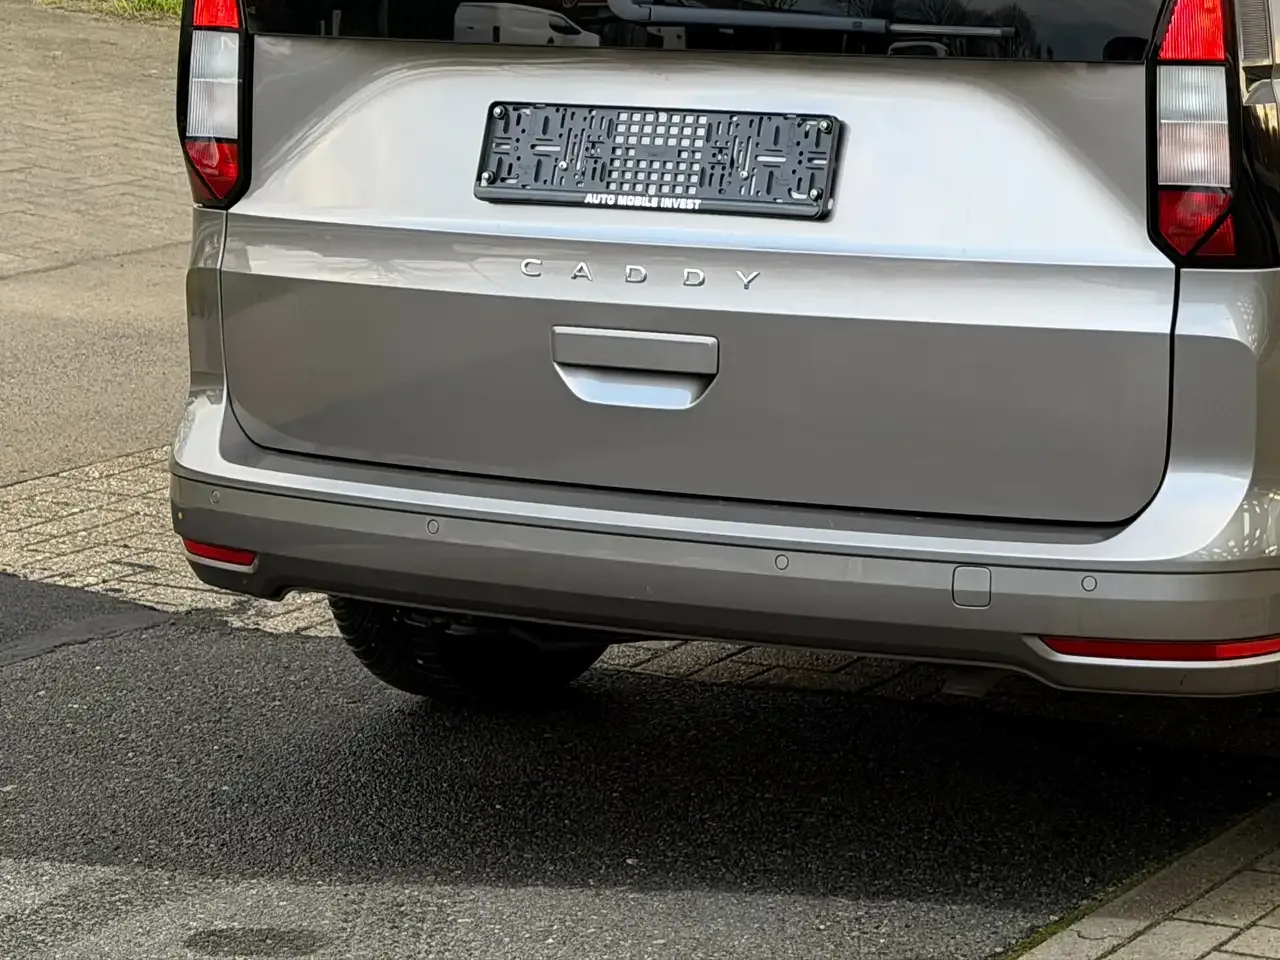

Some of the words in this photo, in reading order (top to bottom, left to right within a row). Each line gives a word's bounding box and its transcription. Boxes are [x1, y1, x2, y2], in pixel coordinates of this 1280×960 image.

[584, 193, 616, 205] AUTO
[618, 195, 659, 208] MOBILE
[660, 197, 702, 210] INVEST
[520, 258, 760, 289] CADDY
